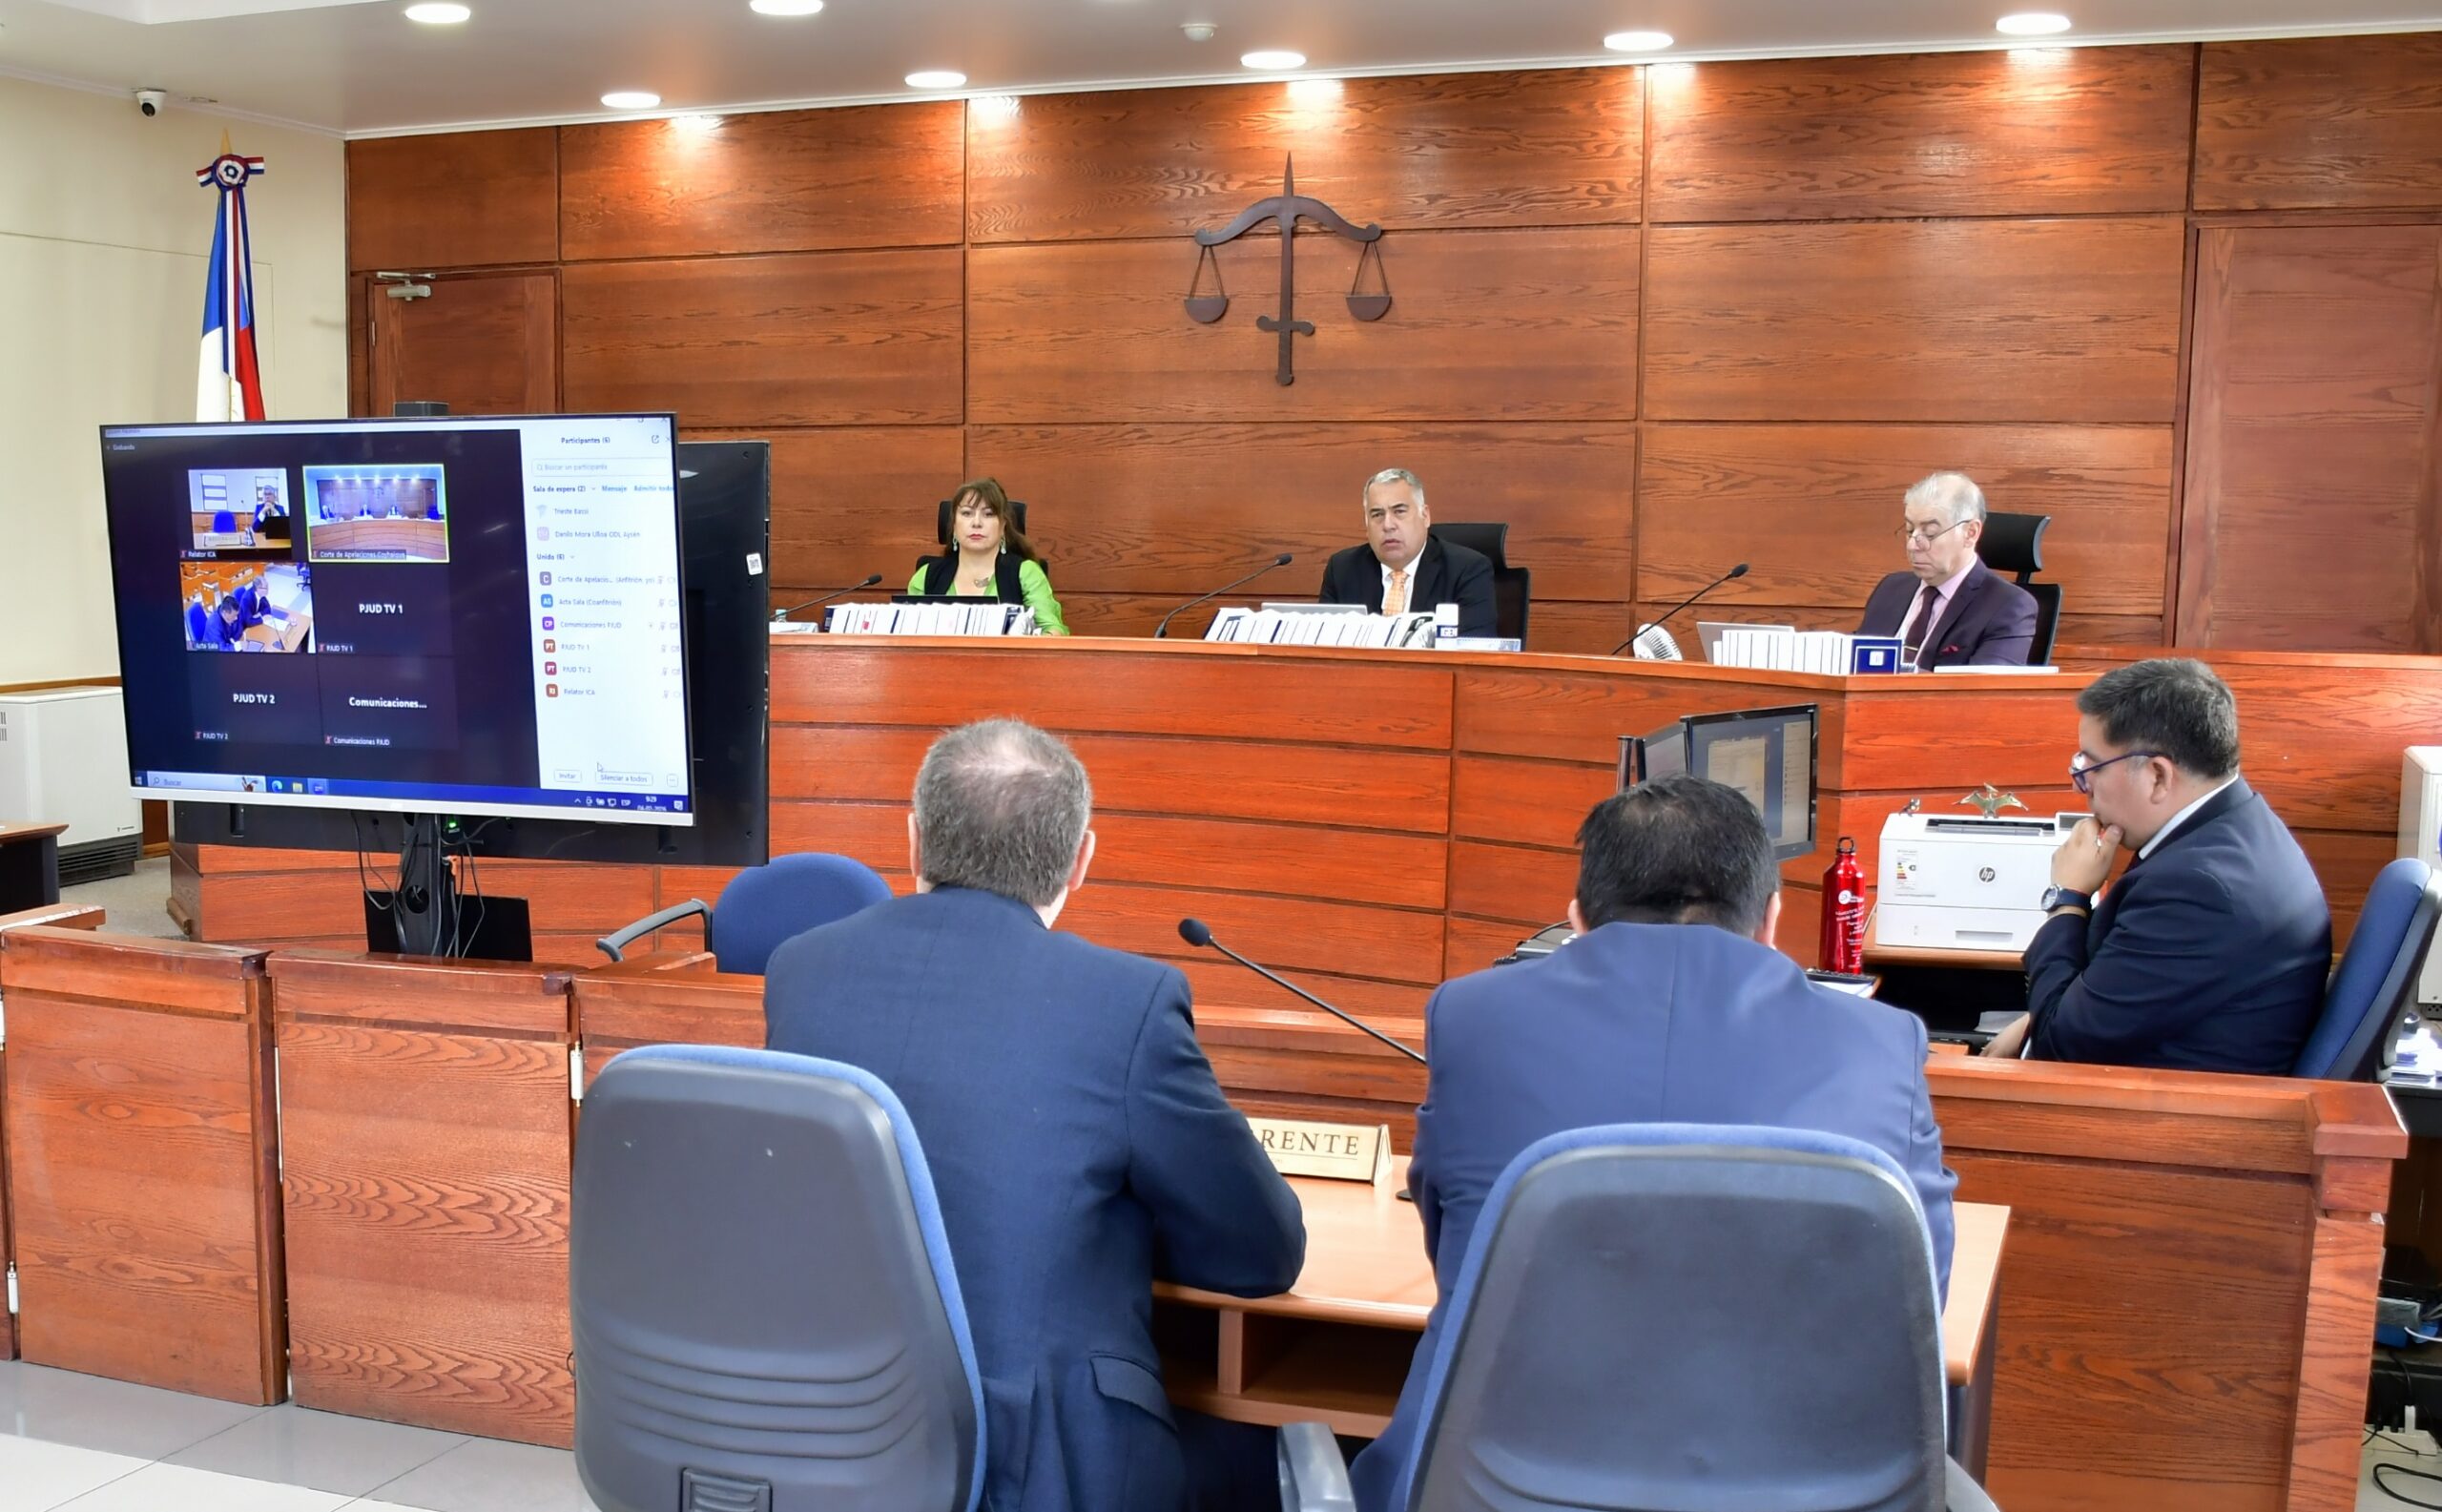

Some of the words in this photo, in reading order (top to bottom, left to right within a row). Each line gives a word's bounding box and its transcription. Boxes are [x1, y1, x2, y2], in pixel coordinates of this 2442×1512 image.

[555, 486, 576, 494] espera
[577, 485, 586, 493] (2)
[542, 574, 549, 584] C
[359, 603, 383, 614] PJUD
[383, 604, 397, 614] TV
[397, 604, 404, 614] 1
[233, 694, 256, 704] PJUD
[256, 694, 268, 704] TV
[269, 694, 276, 705] 2
[348, 696, 427, 710] Comunicaciones...
[333, 736, 376, 746] Comunicaciones
[1980, 867, 1995, 882] hp
[1261, 1129, 1358, 1155] RENTE
